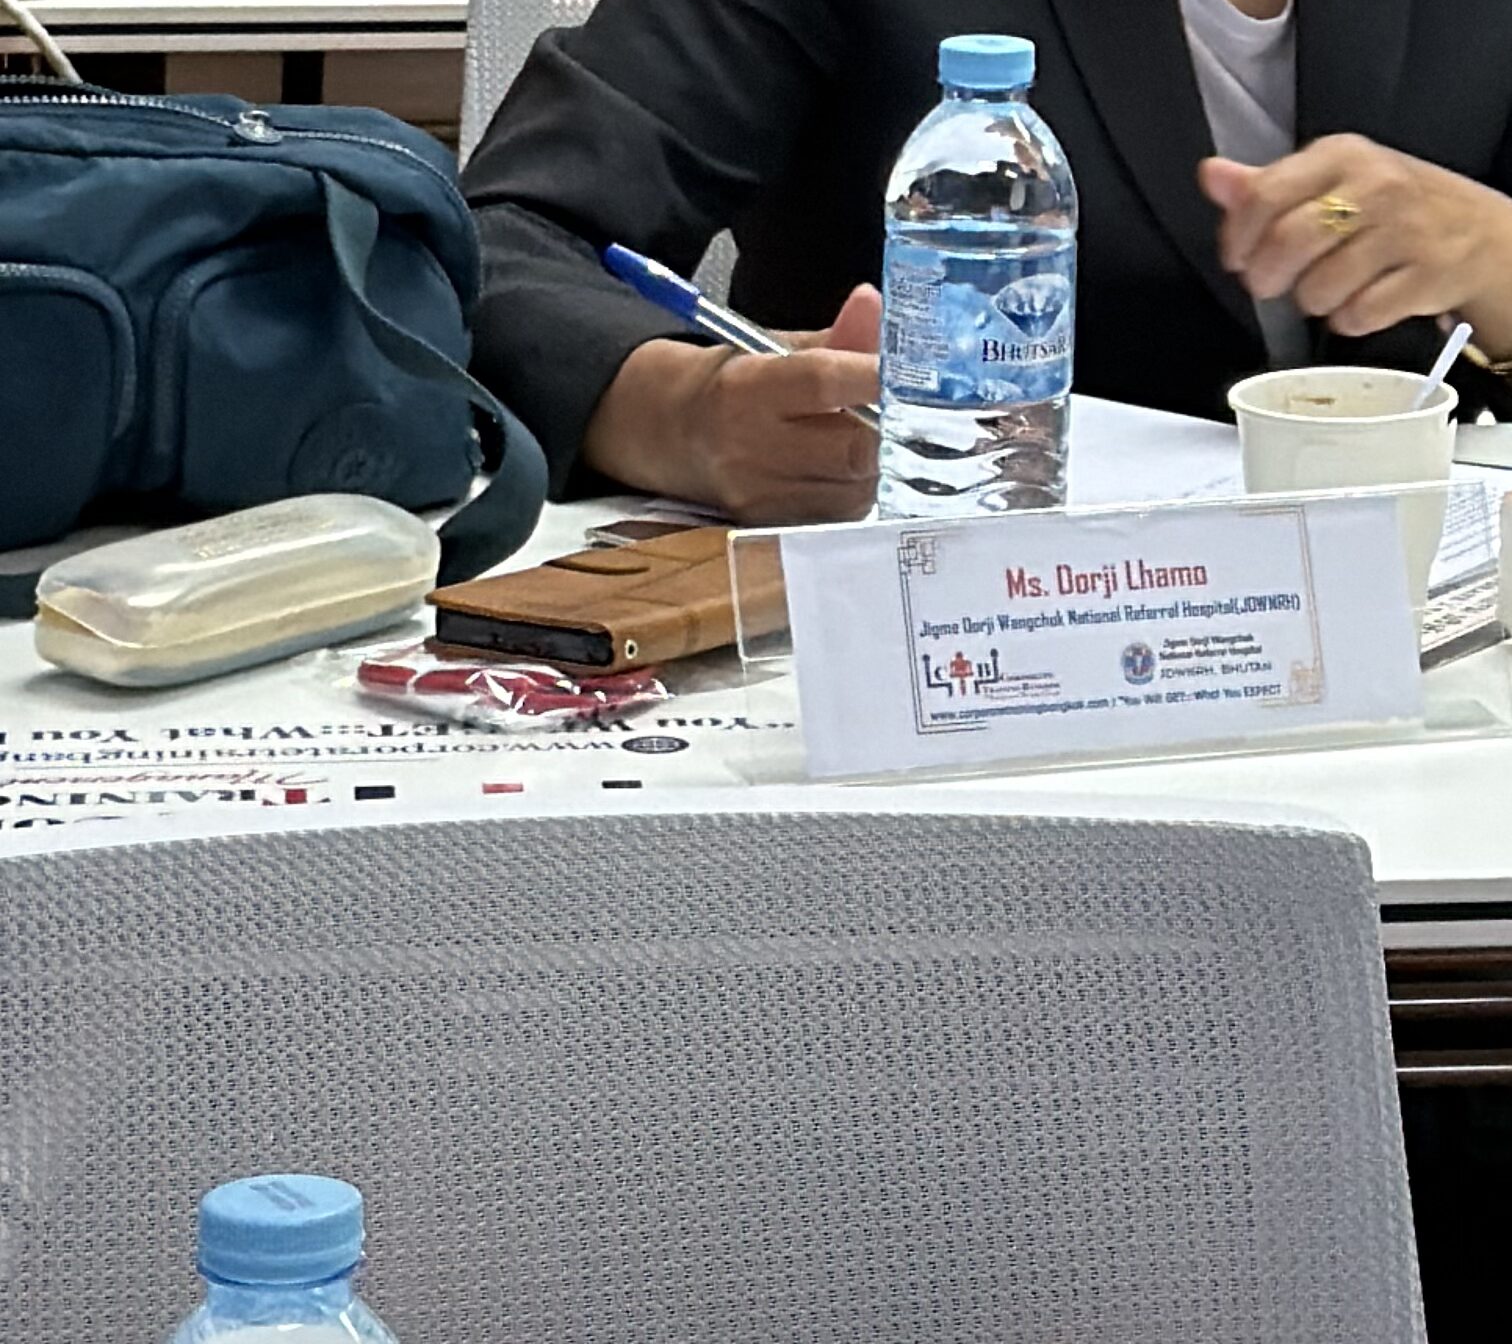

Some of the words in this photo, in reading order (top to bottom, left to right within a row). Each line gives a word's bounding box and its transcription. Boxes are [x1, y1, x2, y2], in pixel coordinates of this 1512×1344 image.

[1005, 568, 1050, 599] Ms.
[1056, 562, 1119, 599] Dorji
[1126, 559, 1208, 590] Lhamo
[919, 619, 960, 640] Jigme
[962, 616, 996, 637] Dorji
[1068, 607, 1122, 625] National
